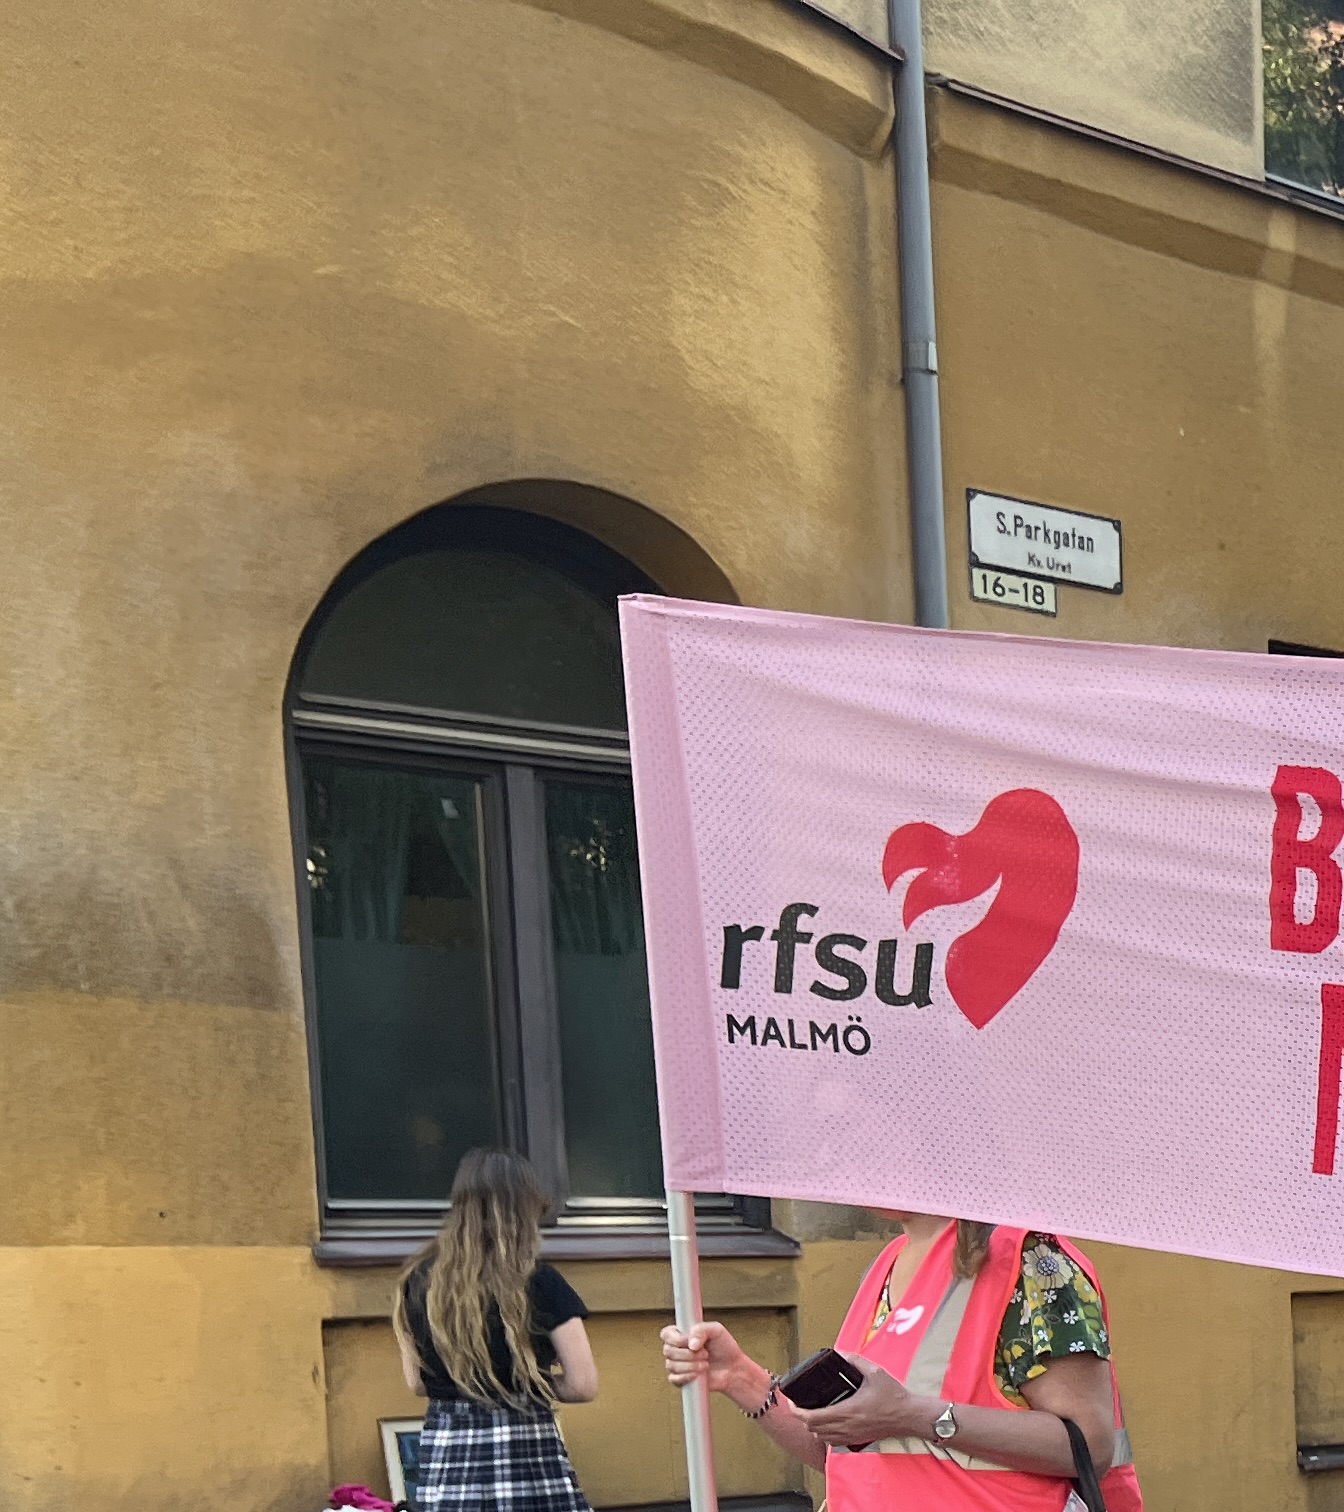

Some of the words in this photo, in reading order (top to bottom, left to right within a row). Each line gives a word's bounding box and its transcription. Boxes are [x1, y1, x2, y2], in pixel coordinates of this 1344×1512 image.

[981, 573, 1045, 606] 16-18
[719, 902, 935, 1010] rfsu
[726, 1014, 871, 1056] MALMÖ
